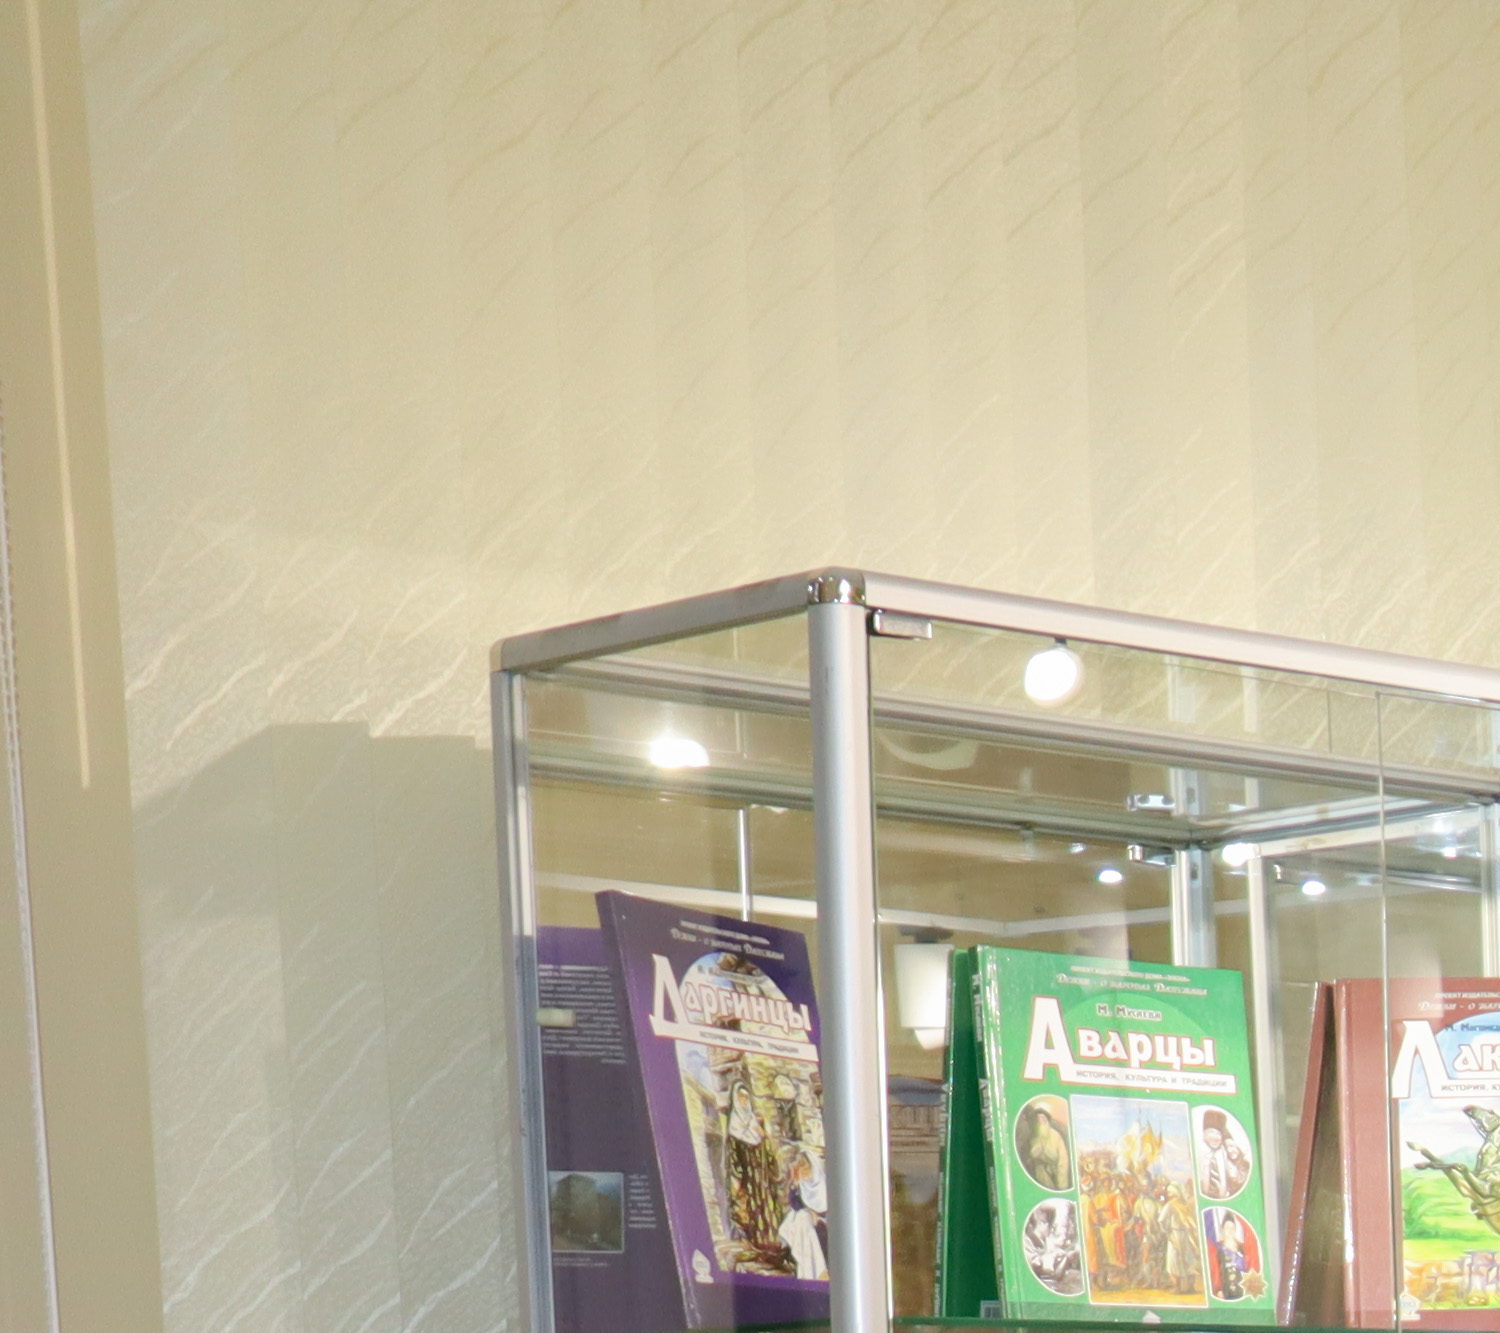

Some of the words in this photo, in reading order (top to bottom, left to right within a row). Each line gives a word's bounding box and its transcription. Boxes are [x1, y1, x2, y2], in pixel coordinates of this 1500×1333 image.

[649, 953, 812, 1035] Даргинцы
[1023, 995, 1216, 1081] Аварцы
[1441, 1083, 1489, 1092] ИСТОРИЯ,
